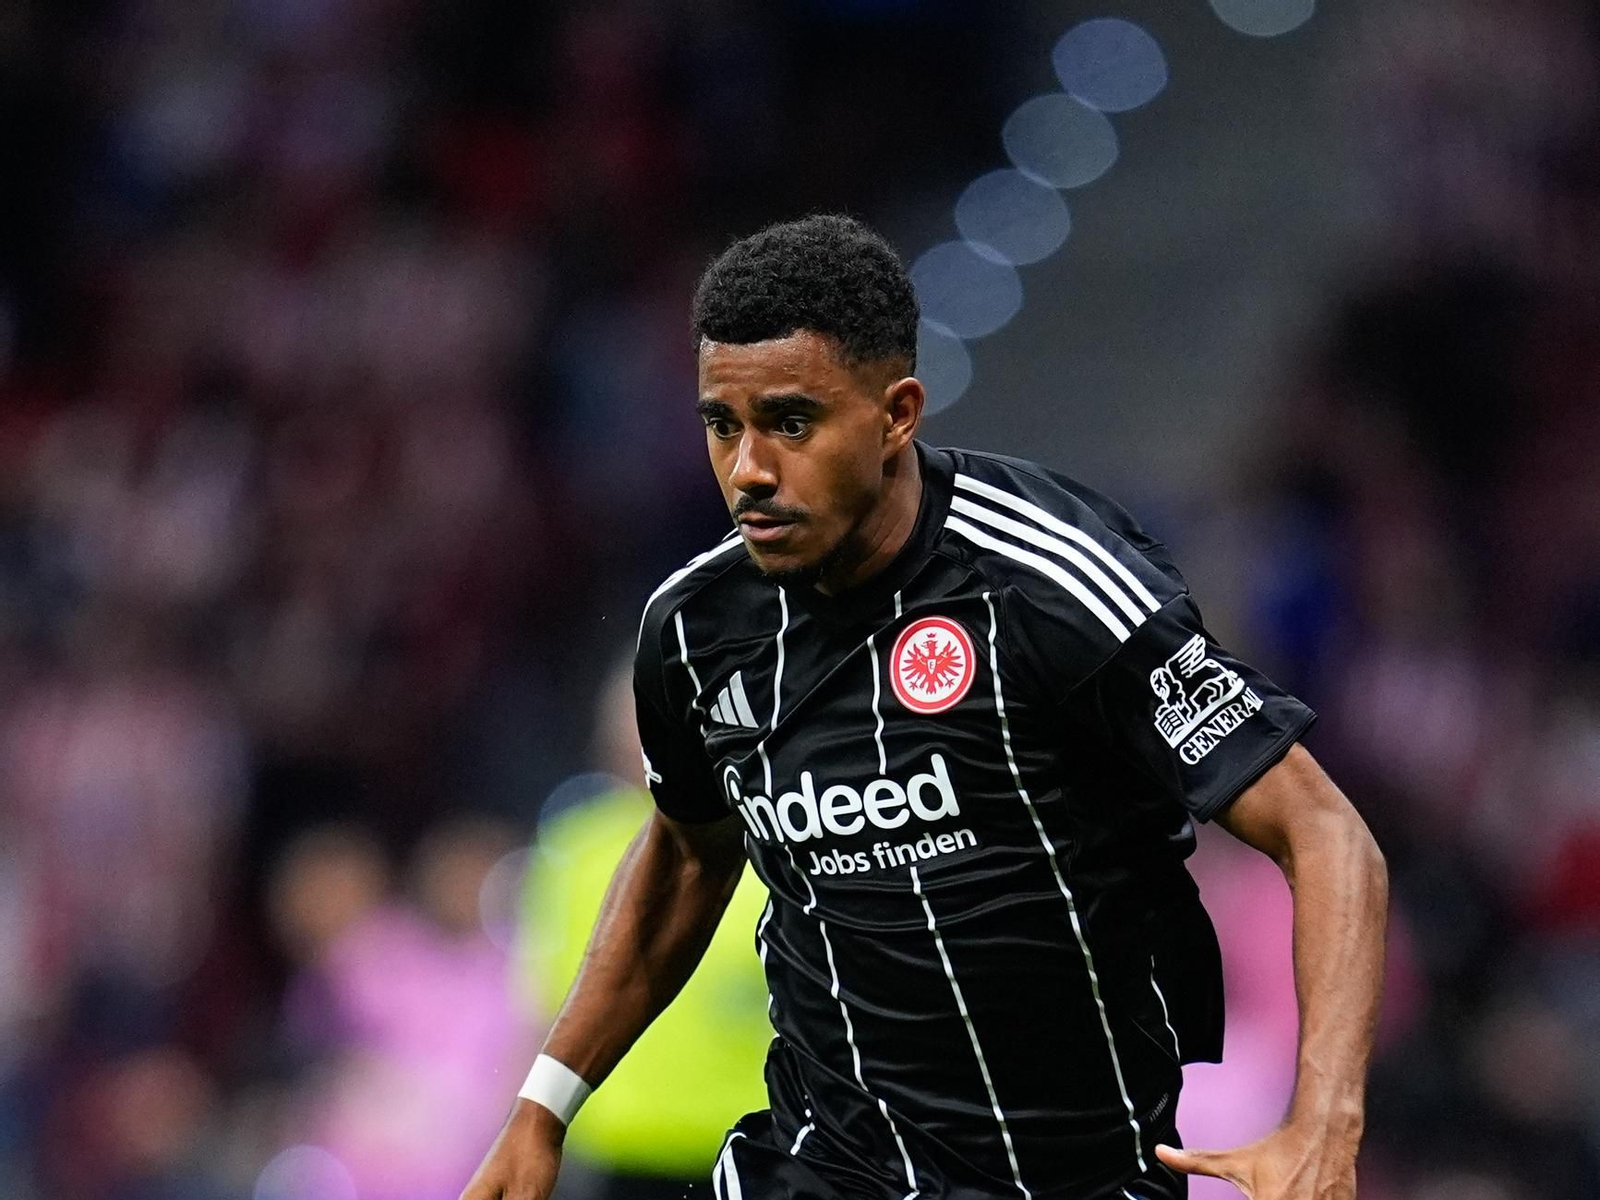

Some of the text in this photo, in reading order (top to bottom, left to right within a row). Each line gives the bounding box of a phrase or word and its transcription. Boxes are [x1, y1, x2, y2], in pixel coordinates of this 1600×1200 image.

[723, 753, 961, 843] indeed
[809, 828, 978, 876] Jobs finden
